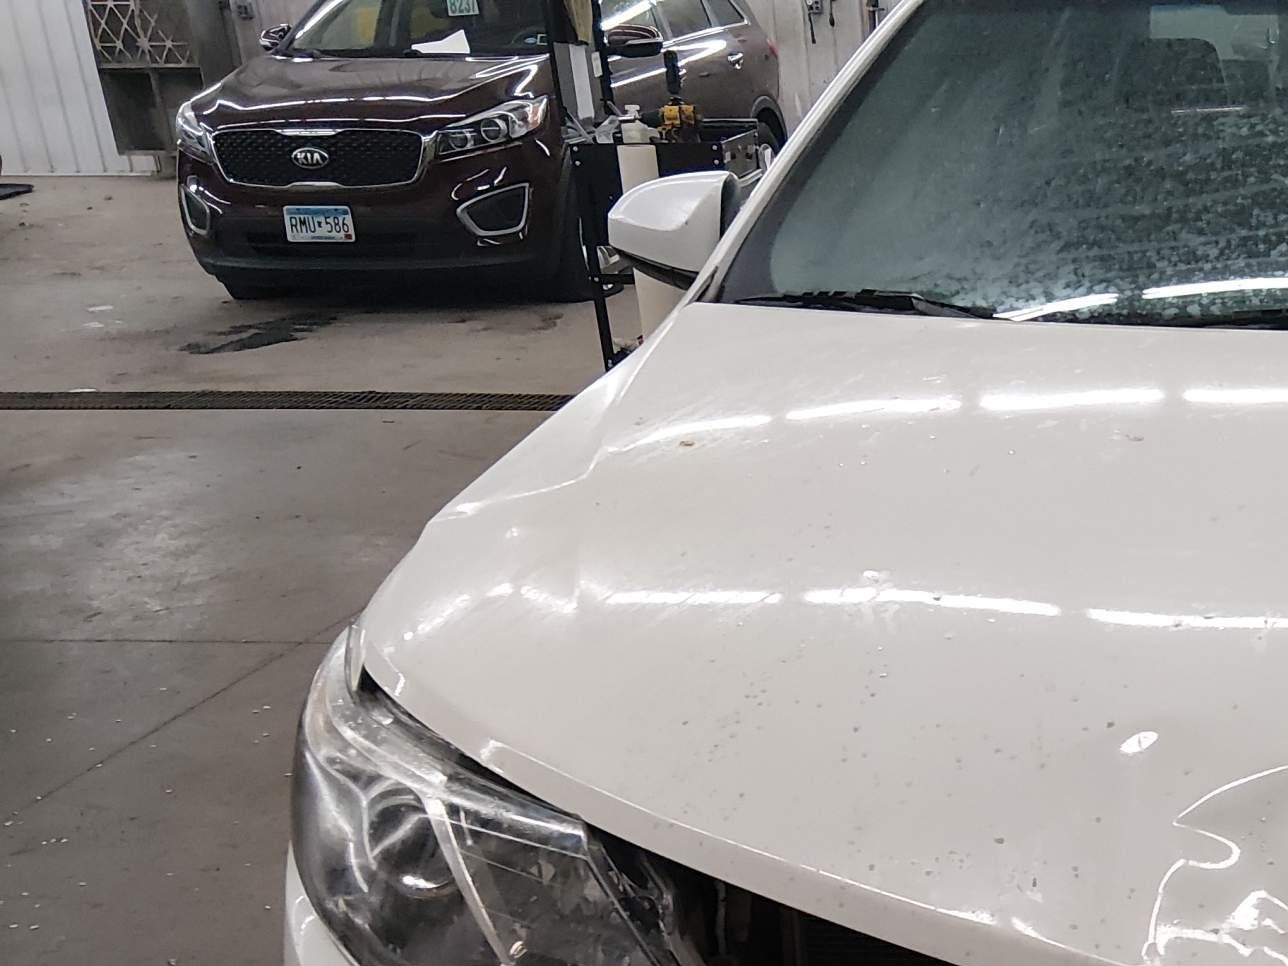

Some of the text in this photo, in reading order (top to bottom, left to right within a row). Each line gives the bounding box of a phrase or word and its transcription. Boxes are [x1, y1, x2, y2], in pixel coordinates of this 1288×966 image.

[297, 152, 323, 164] KIA
[289, 215, 350, 234] RMU 586
